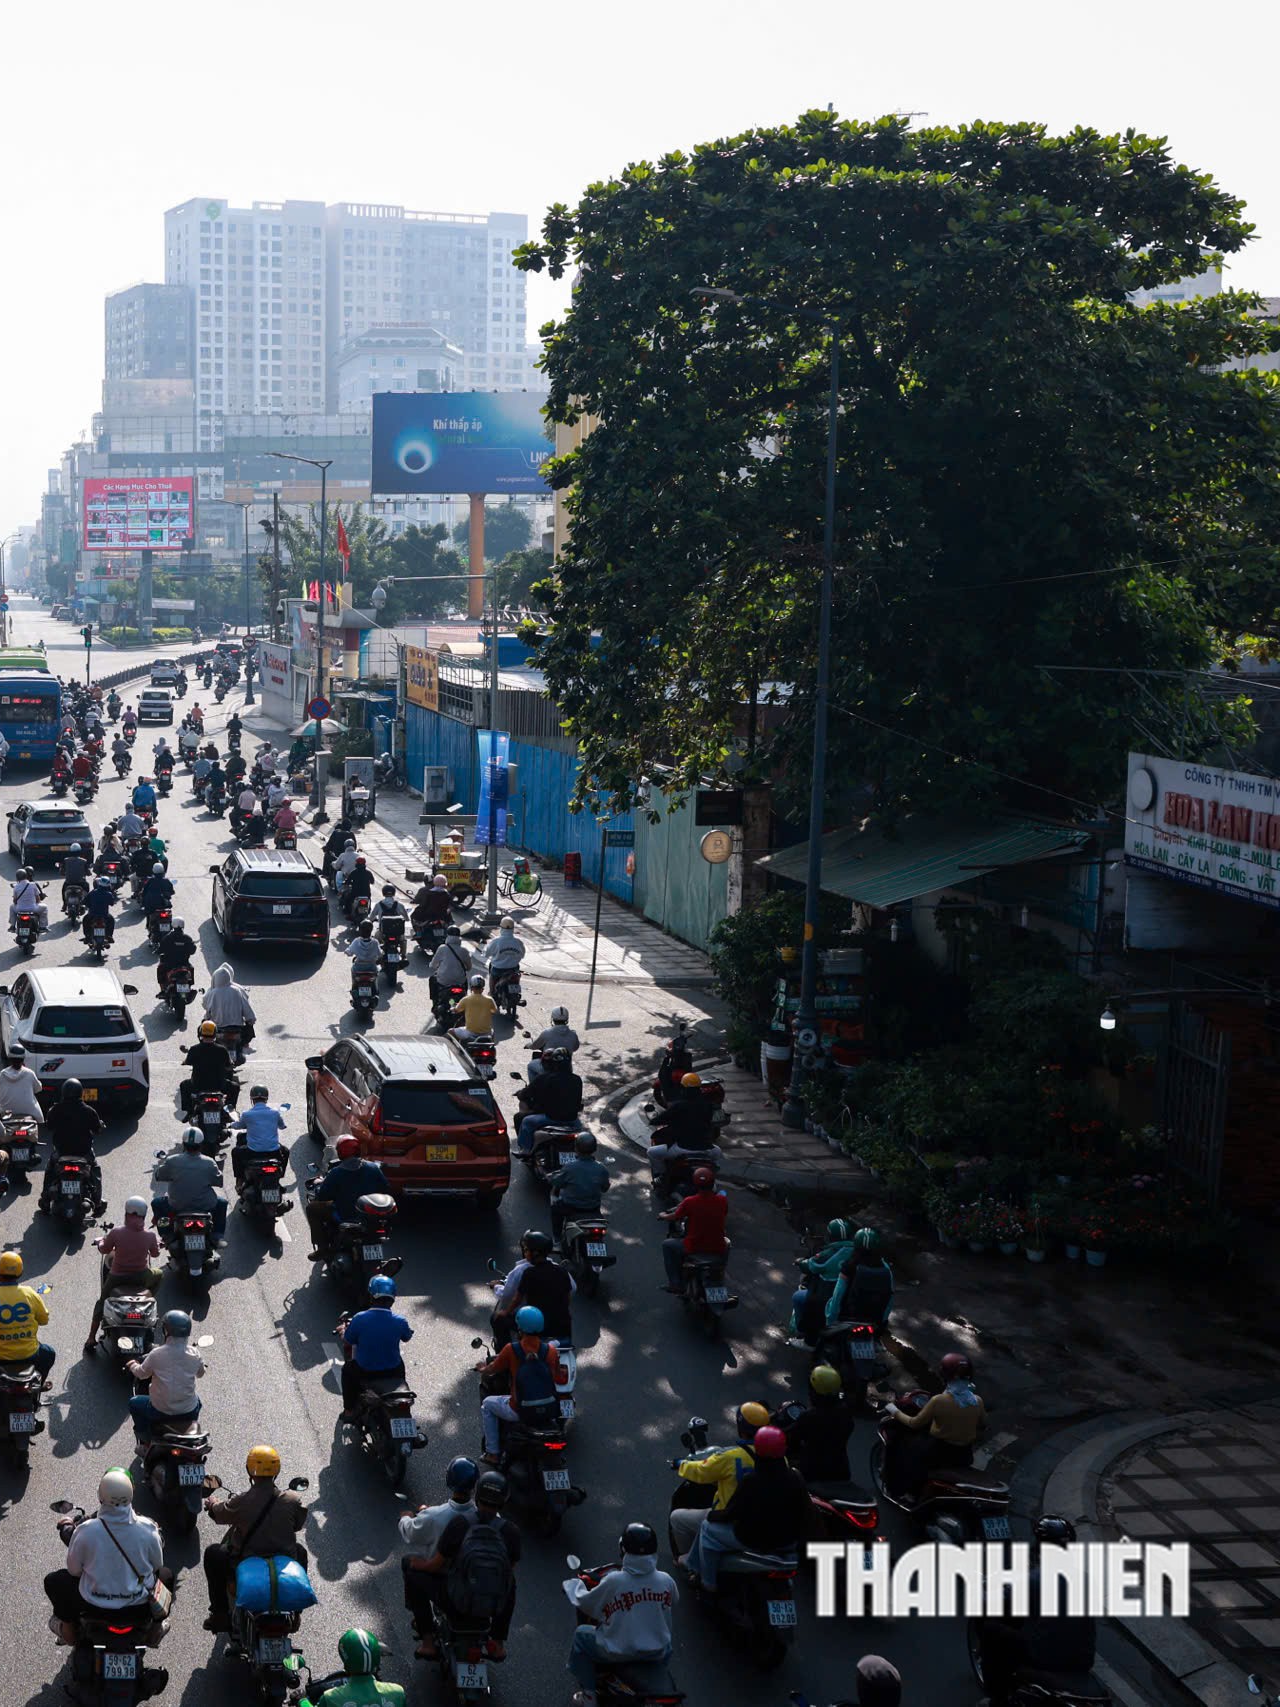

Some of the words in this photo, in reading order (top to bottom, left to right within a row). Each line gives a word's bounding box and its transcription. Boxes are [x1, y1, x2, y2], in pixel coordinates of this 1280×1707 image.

[433, 418, 449, 431] Khí
[450, 415, 470, 433] thấp
[471, 417, 483, 433] áp
[1184, 767, 1212, 786] CÔNG
[1213, 774, 1226, 789] TY
[1228, 778, 1255, 795] TNHH
[1257, 783, 1272, 798] TM
[1164, 791, 1205, 834] HOA
[1207, 800, 1253, 845] LAN
[1134, 840, 1150, 858] HOA
[1152, 847, 1169, 862] LAN
[1178, 852, 1195, 870] CÂY
[1219, 862, 1246, 884] GIỐNG
[1257, 870, 1276, 894] VẬT
[1251, 851, 1272, 867] MUA
[108, 1655, 132, 1665] 59-G2
[105, 1666, 135, 1678] 799.38
[467, 1665, 477, 1675] 62
